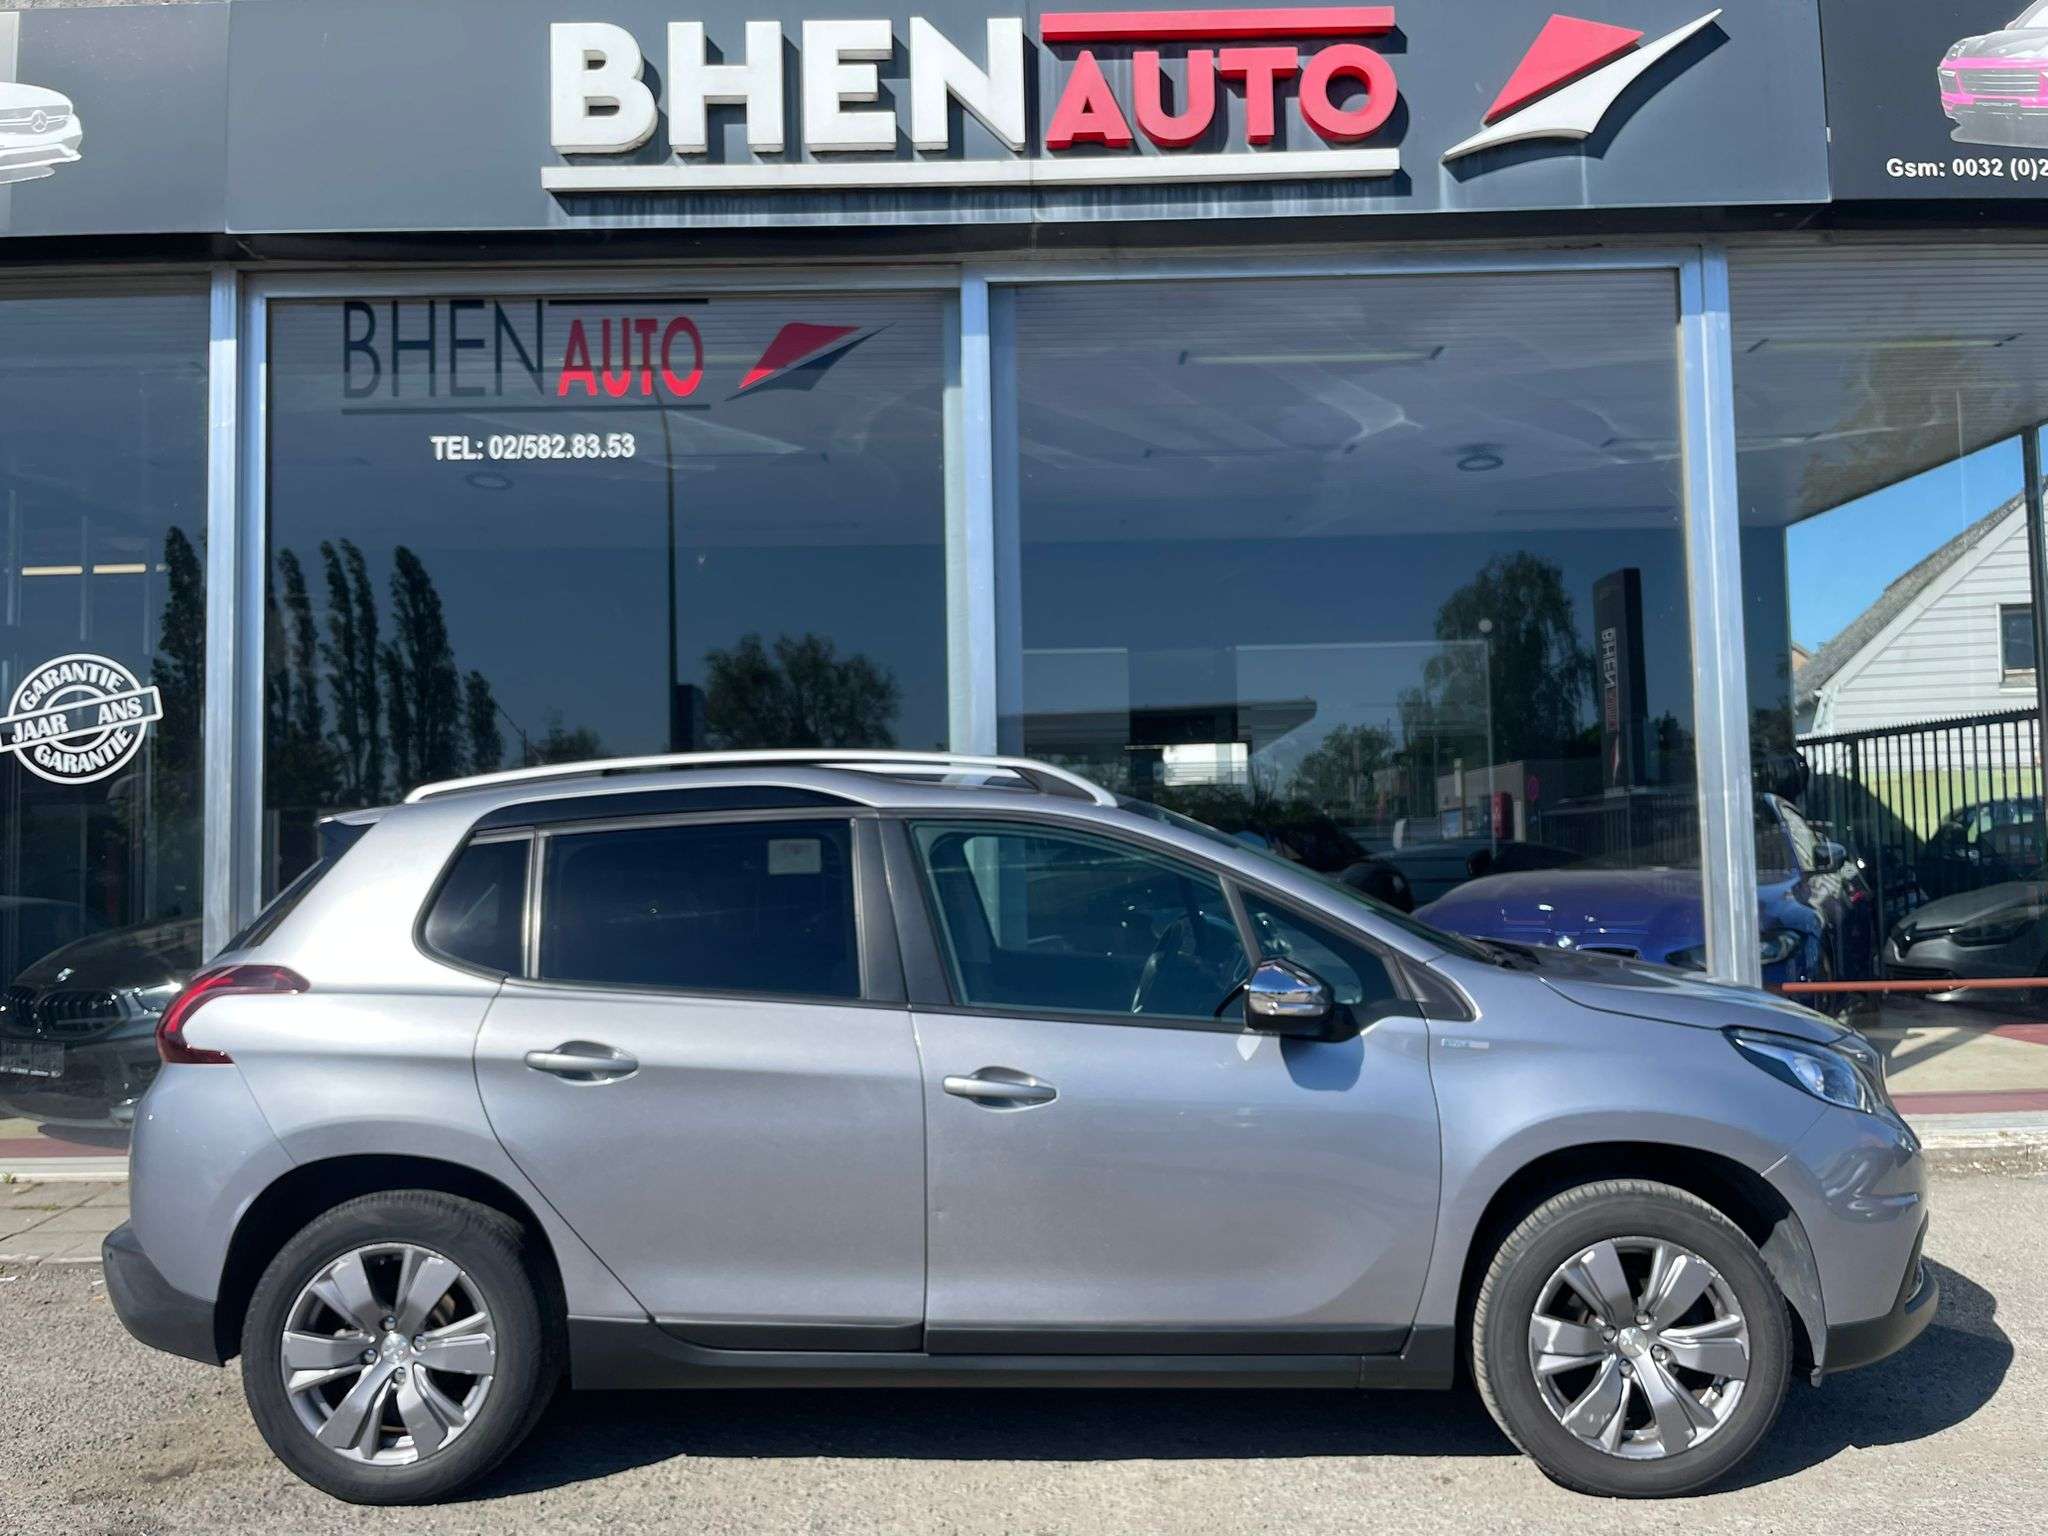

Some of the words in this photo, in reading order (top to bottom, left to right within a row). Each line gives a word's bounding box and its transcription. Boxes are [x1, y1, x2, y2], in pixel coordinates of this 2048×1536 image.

[550, 17, 1026, 154] BHEN
[1045, 43, 1399, 151] AUTO
[1886, 157, 1946, 178] Gsm:
[1952, 157, 2004, 177] 0032
[343, 299, 545, 398] BHEN
[557, 316, 704, 398] AUTO
[431, 434, 483, 461] TEL:
[488, 432, 636, 460] 02/582.83.53
[19, 662, 125, 711] GARANTIE
[11, 713, 69, 744] JAAR
[97, 696, 144, 726] ANS
[34, 727, 134, 774] GARANTIE
